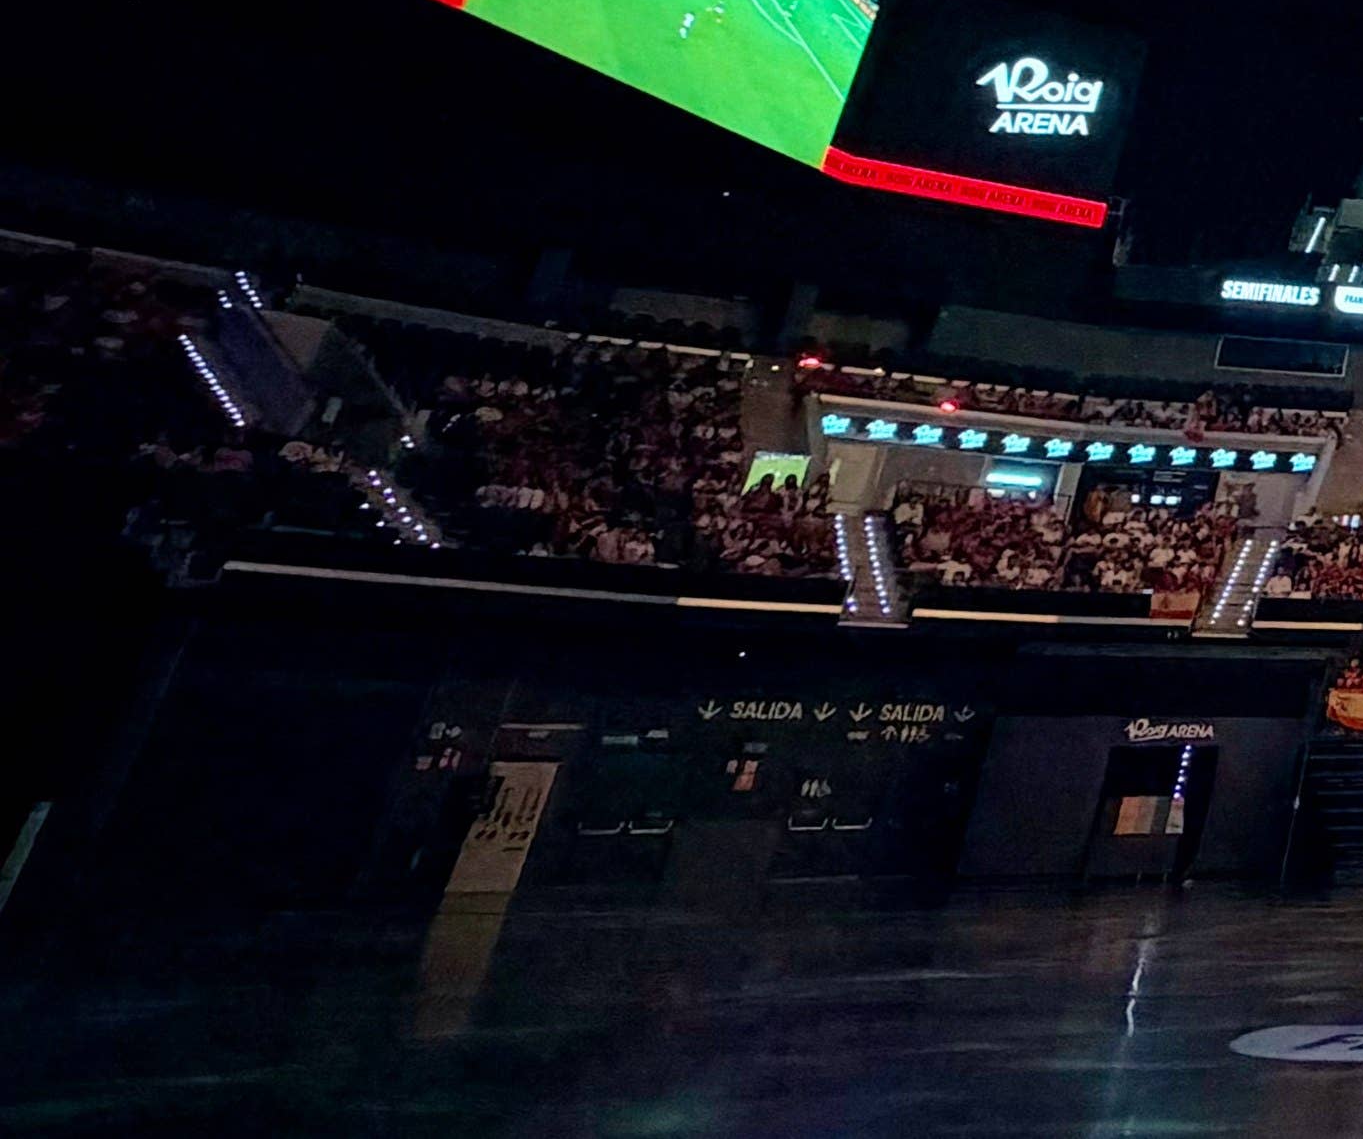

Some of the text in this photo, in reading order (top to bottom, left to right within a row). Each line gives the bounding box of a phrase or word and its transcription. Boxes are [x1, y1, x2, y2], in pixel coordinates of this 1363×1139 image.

[976, 57, 1103, 113] Roig
[988, 111, 1089, 136] ARENA
[1220, 279, 1320, 306] SEMIFINALES
[729, 701, 803, 721] SALIDA
[879, 703, 945, 723] SALIDA
[1167, 724, 1215, 739] ARENA
